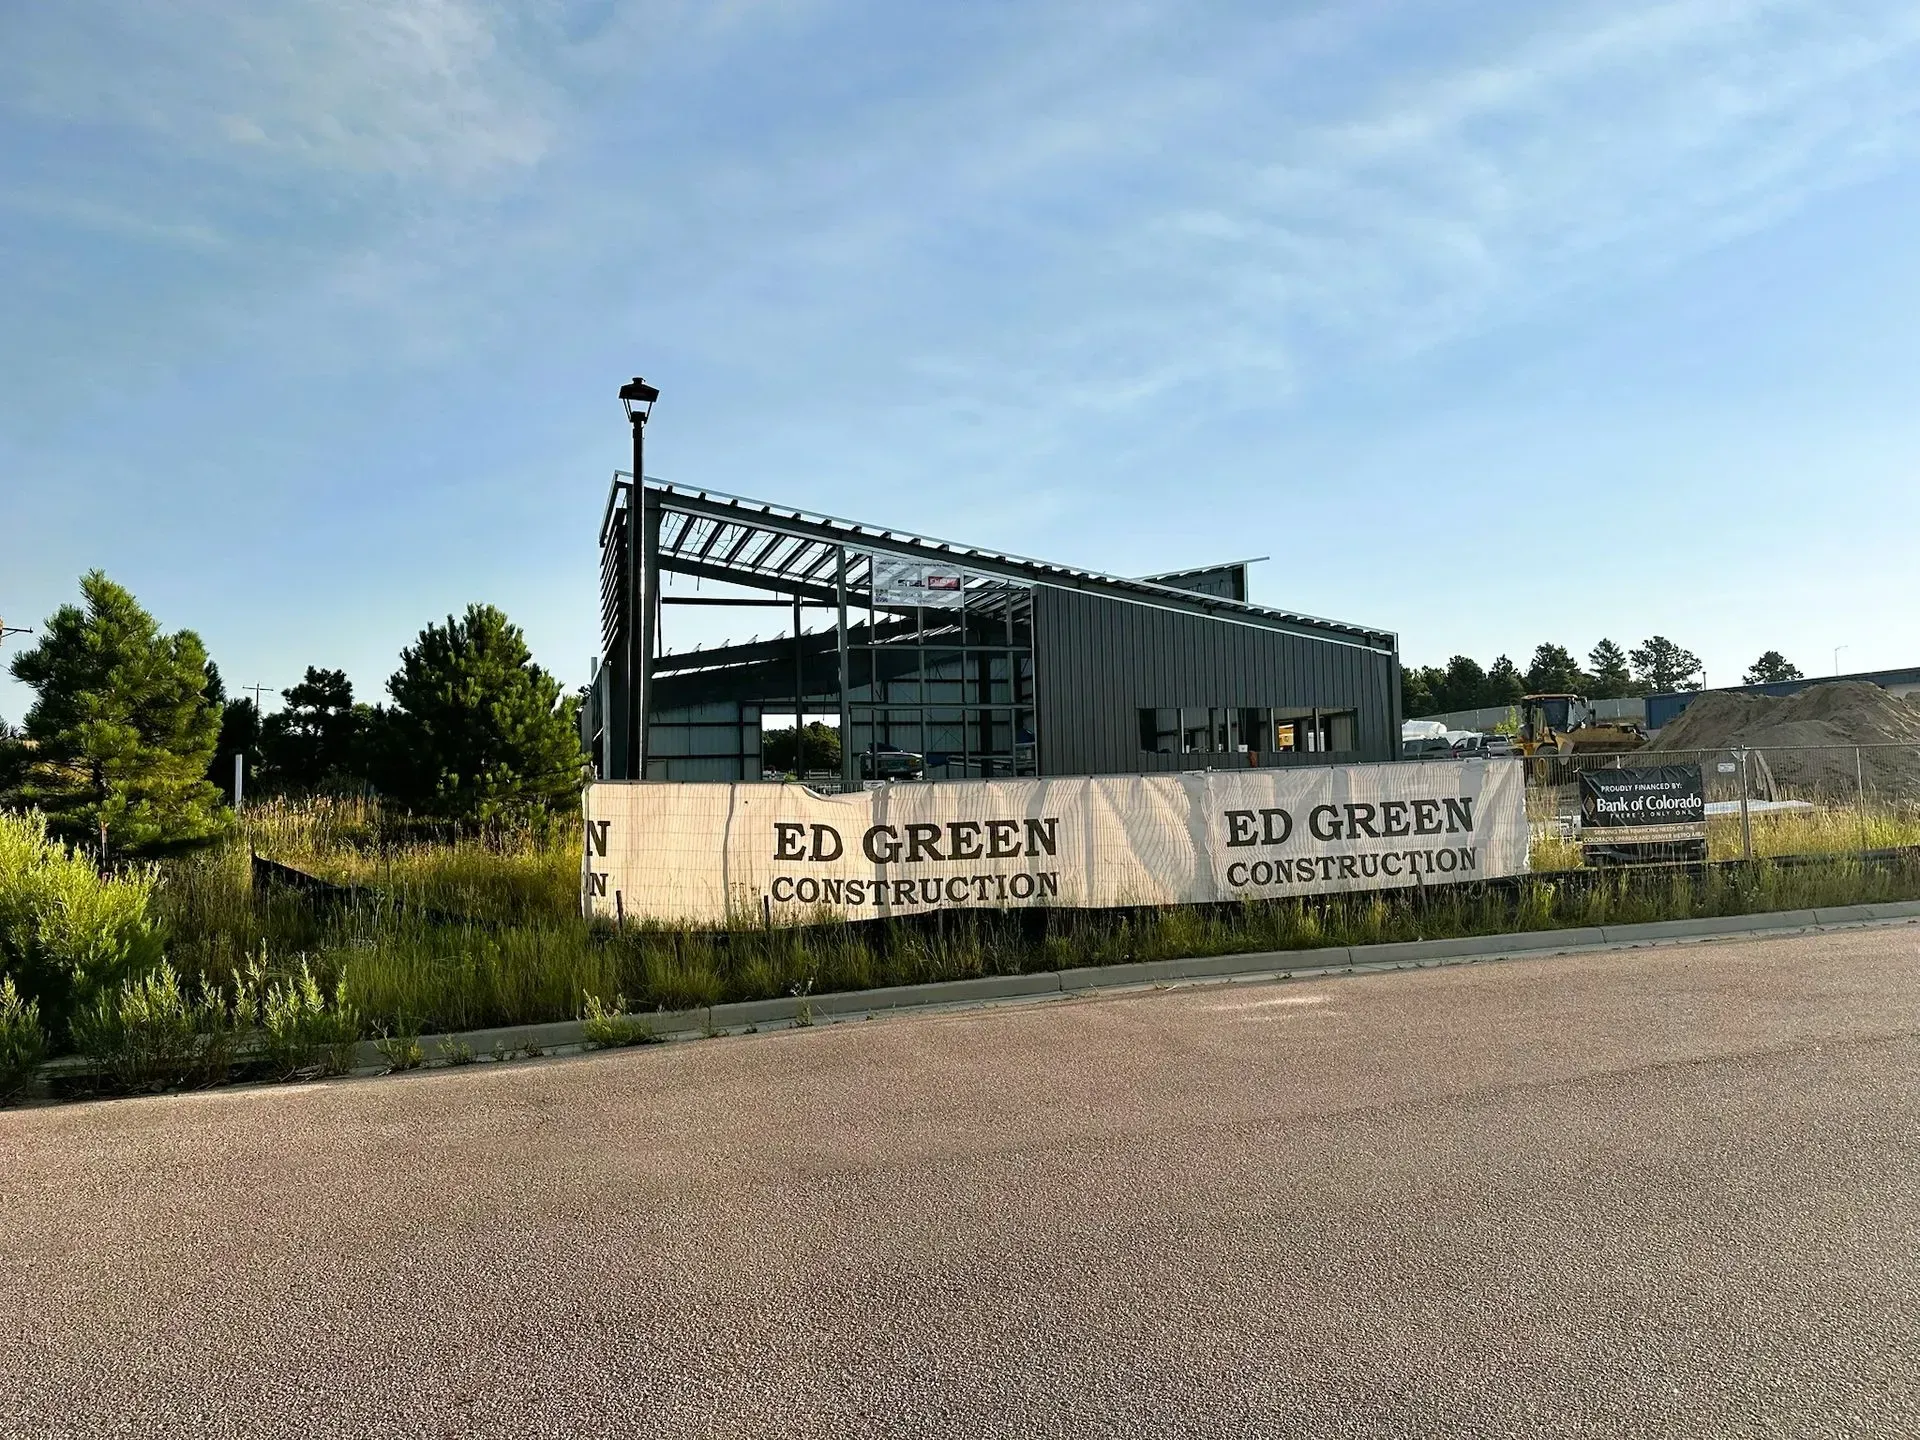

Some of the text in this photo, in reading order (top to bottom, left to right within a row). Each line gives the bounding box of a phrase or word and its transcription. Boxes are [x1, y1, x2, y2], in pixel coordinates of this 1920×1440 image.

[1601, 782, 1683, 793] PROUDLY FINANCED BY:
[1596, 793, 1702, 813] Bank of Colorado
[1610, 811, 1645, 819] THERE'S
[1649, 810, 1671, 818] ONLY
[1223, 797, 1474, 848] ED GREEN
[1651, 832, 1672, 840] DENVER
[773, 817, 1059, 864] ED GREEN
[1226, 846, 1477, 888] CONSTRUCTION
[771, 872, 1059, 906] CONSTRUCTION
